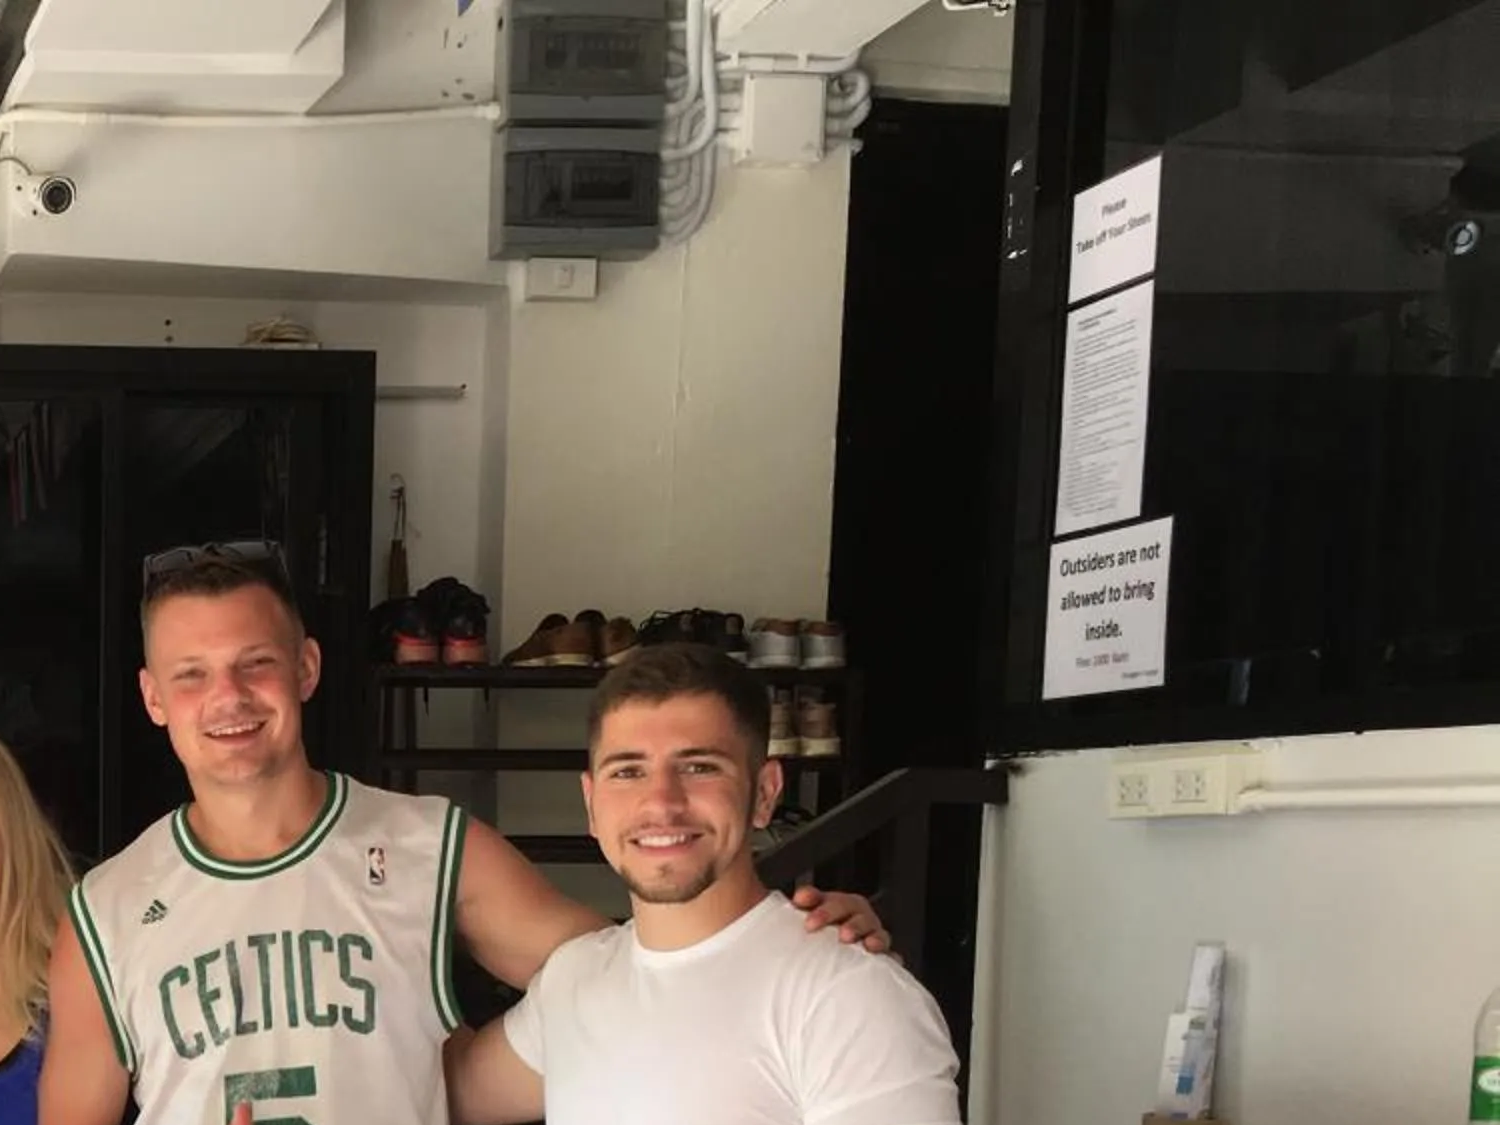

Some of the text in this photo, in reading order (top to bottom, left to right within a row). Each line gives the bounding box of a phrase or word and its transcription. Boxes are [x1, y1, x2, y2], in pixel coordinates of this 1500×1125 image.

[1060, 543, 1161, 577] Outsiders are not
[1060, 580, 1156, 610] allowed to bring
[1085, 619, 1122, 641] inside.
[159, 929, 376, 1060] CELTICS
